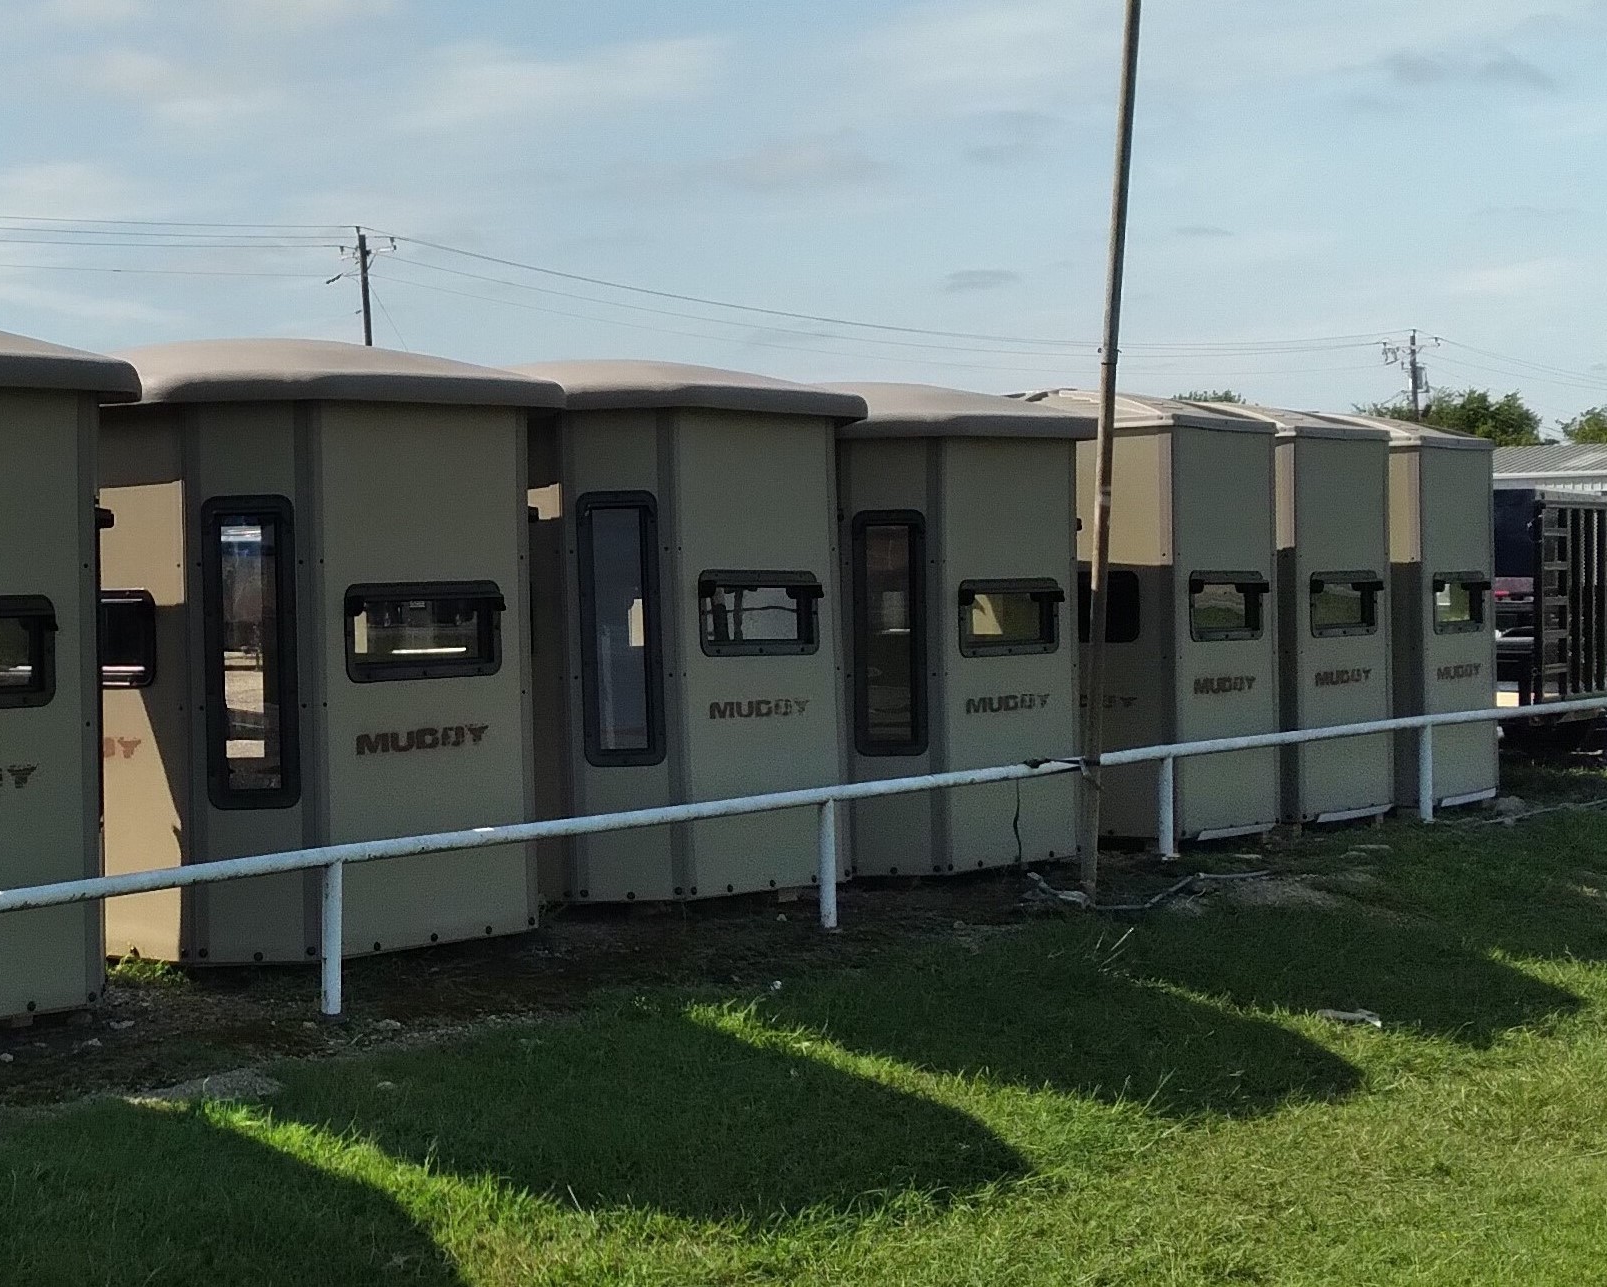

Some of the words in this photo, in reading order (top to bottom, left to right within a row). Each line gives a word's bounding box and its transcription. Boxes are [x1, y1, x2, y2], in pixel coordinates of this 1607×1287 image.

[1314, 668, 1372, 687] MUDDY
[1437, 663, 1483, 681] MUDDY
[1194, 676, 1256, 694] MUDDY
[708, 698, 810, 719] MUDDY
[965, 693, 1050, 714] MUDDY
[355, 724, 490, 755] MUDDY
